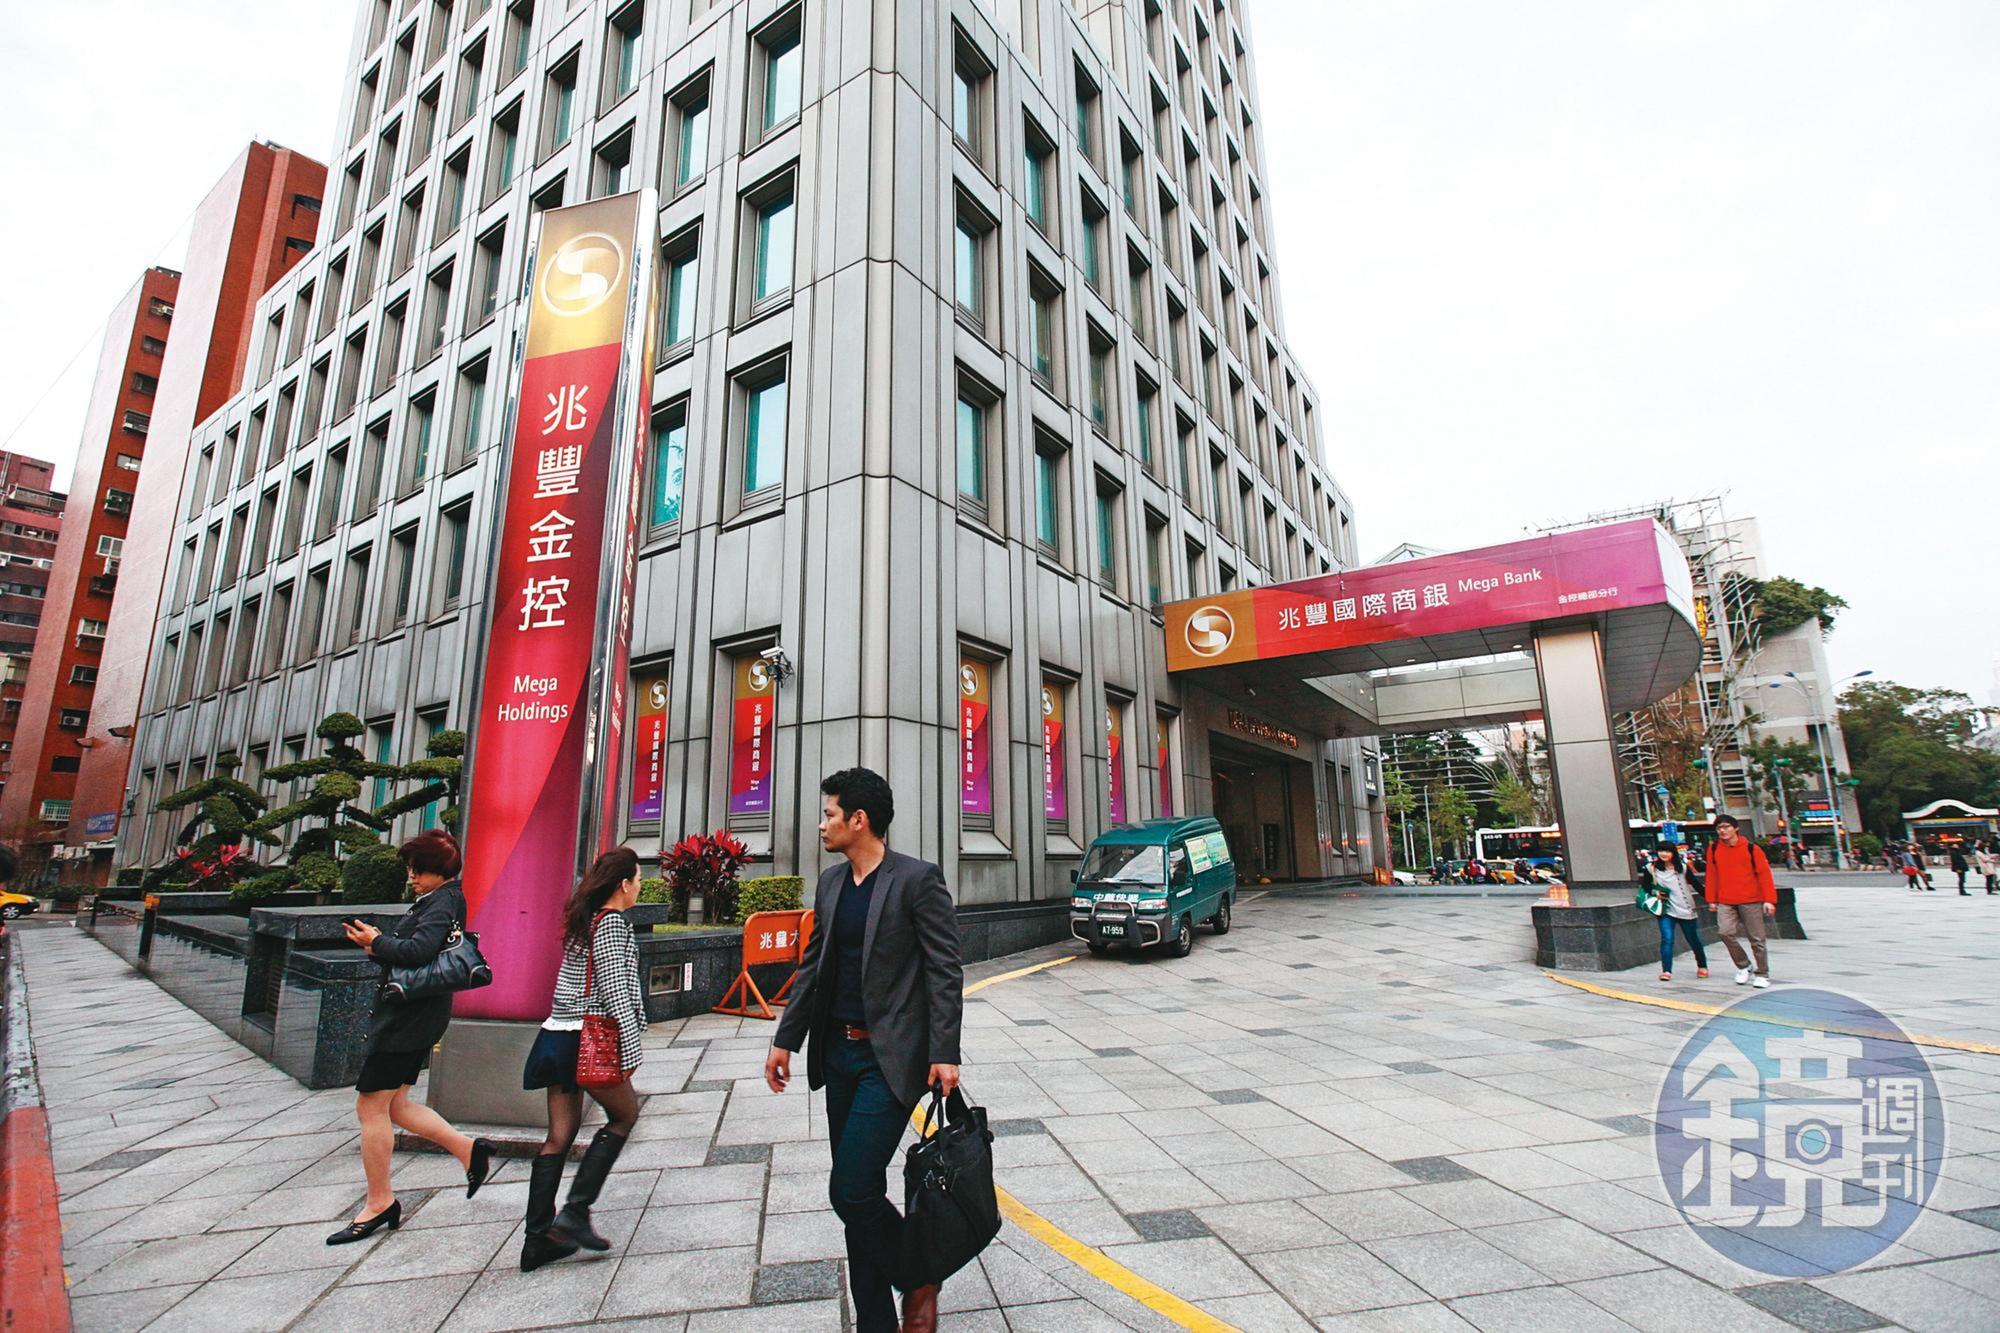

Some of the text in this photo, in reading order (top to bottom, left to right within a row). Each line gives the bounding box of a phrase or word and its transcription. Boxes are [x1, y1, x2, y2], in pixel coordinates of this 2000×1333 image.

[518, 384, 589, 633] 兆豐金控
[1458, 567, 1543, 594] Mega Bank
[1278, 582, 1450, 631] 兆豐國際商銀
[513, 674, 559, 697] Mega
[498, 702, 569, 724] Holdings
